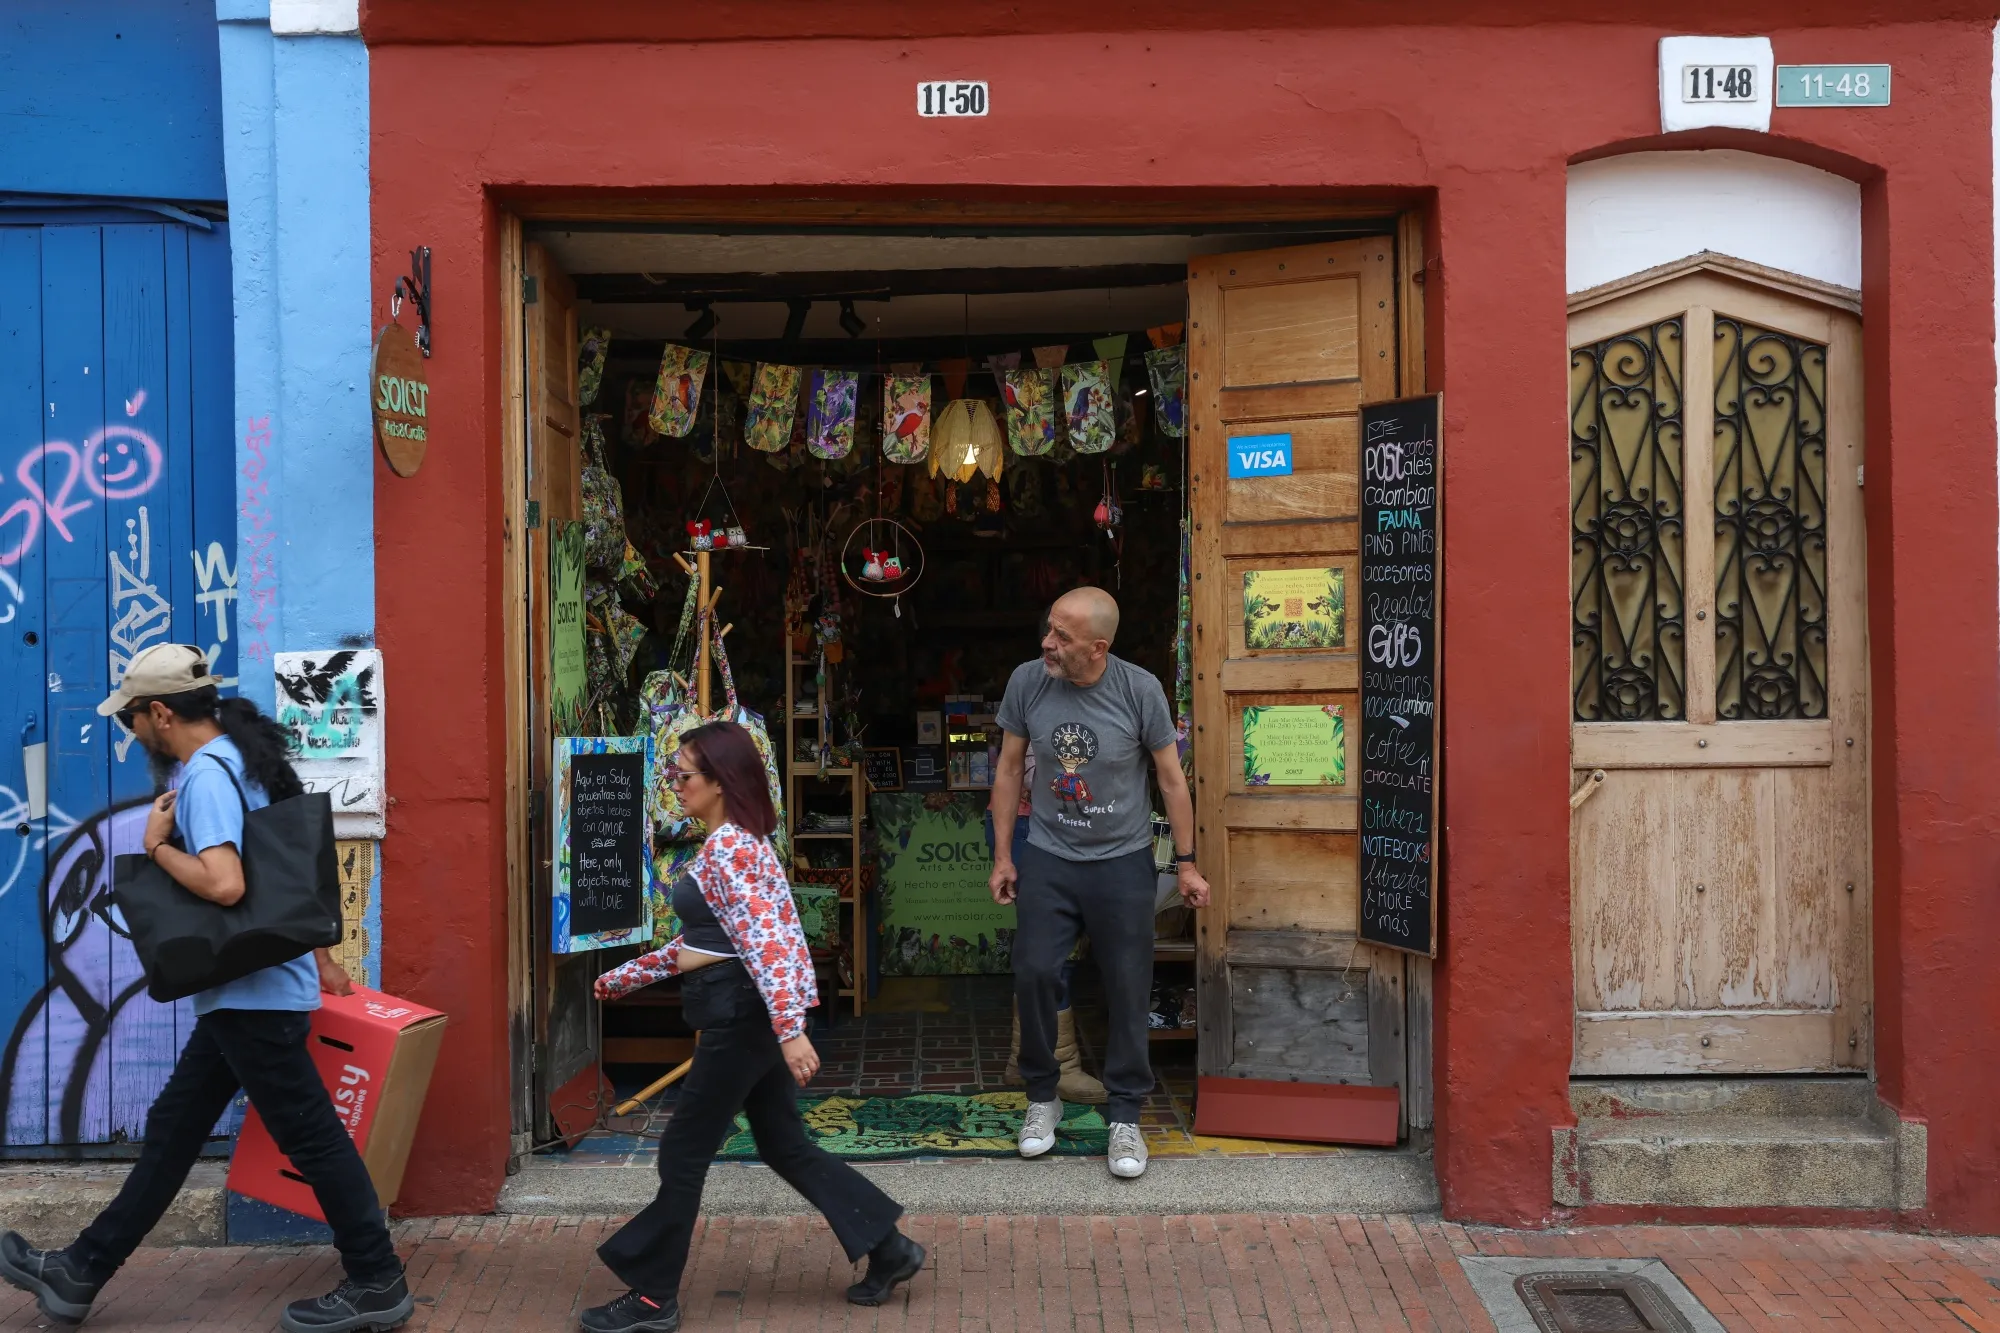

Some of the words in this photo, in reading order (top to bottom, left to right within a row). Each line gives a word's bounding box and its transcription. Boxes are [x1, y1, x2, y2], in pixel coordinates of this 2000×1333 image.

[1800, 73, 1870, 98] 11-48
[1237, 450, 1286, 469] VISA
[1378, 508, 1421, 532] FAUNA
[1365, 533, 1394, 556] PINS
[1402, 530, 1434, 554] PINES
[1364, 563, 1432, 585] accesories
[1364, 671, 1432, 698] souvenirs
[596, 774, 607, 785] en
[1364, 769, 1431, 794] CHOCOLATE
[577, 787, 615, 802] encuentras
[617, 788, 632, 800] solo
[577, 803, 604, 819] objetos
[607, 803, 631, 817] hechos
[582, 821, 596, 834] con
[1363, 836, 1430, 864] NOTEBOOKS
[579, 852, 601, 872] Here,
[604, 852, 622, 872] only
[919, 863, 942, 872] Arts
[948, 863, 955, 871] &
[577, 873, 609, 889] objects
[611, 871, 632, 888] made
[904, 879, 939, 889] Hecho
[942, 881, 955, 889] en
[578, 890, 598, 908] with
[1378, 891, 1412, 910] MORE
[914, 912, 1003, 921] www.misolar.co
[1379, 914, 1410, 937] más
[351, 1088, 367, 1127] apples
